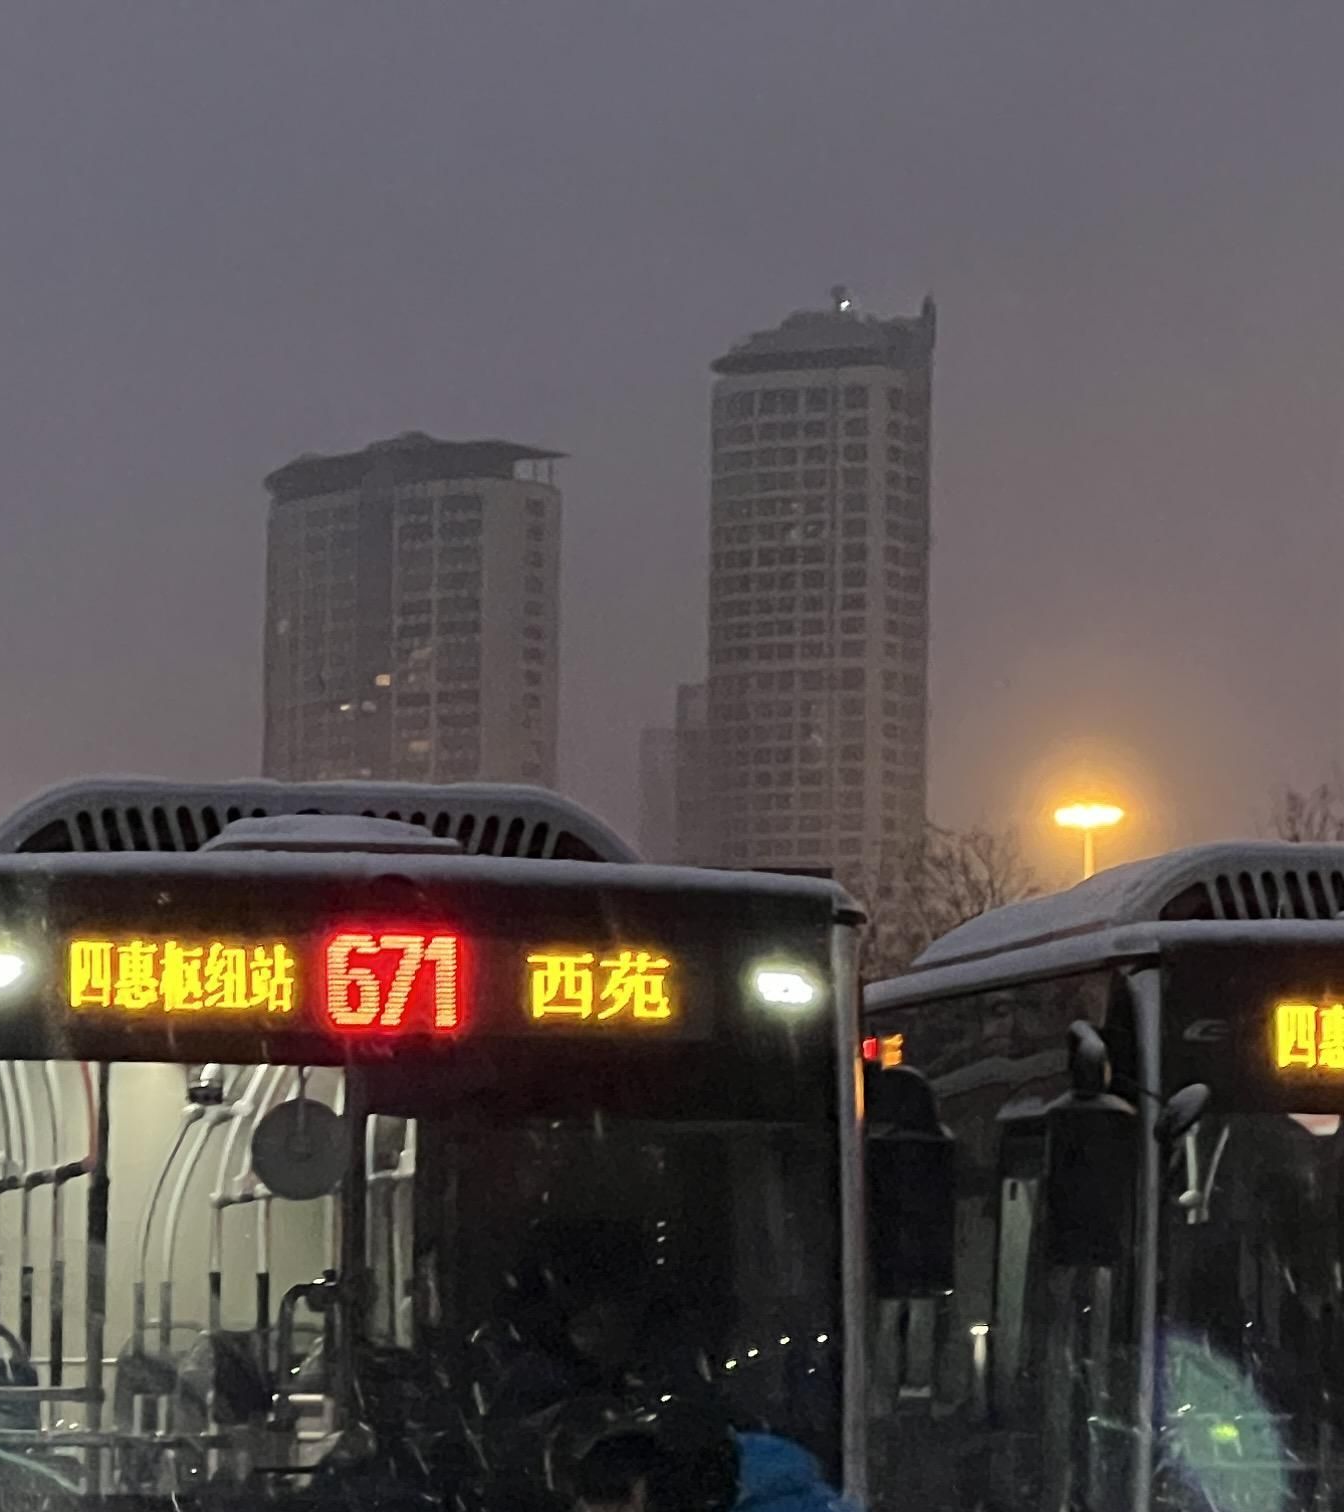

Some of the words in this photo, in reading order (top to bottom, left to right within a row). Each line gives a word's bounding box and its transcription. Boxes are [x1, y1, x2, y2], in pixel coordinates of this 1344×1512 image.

[69, 940, 296, 1011] 四惠枢纽站
[326, 934, 458, 1028] 671
[526, 951, 672, 1020] 西苑
